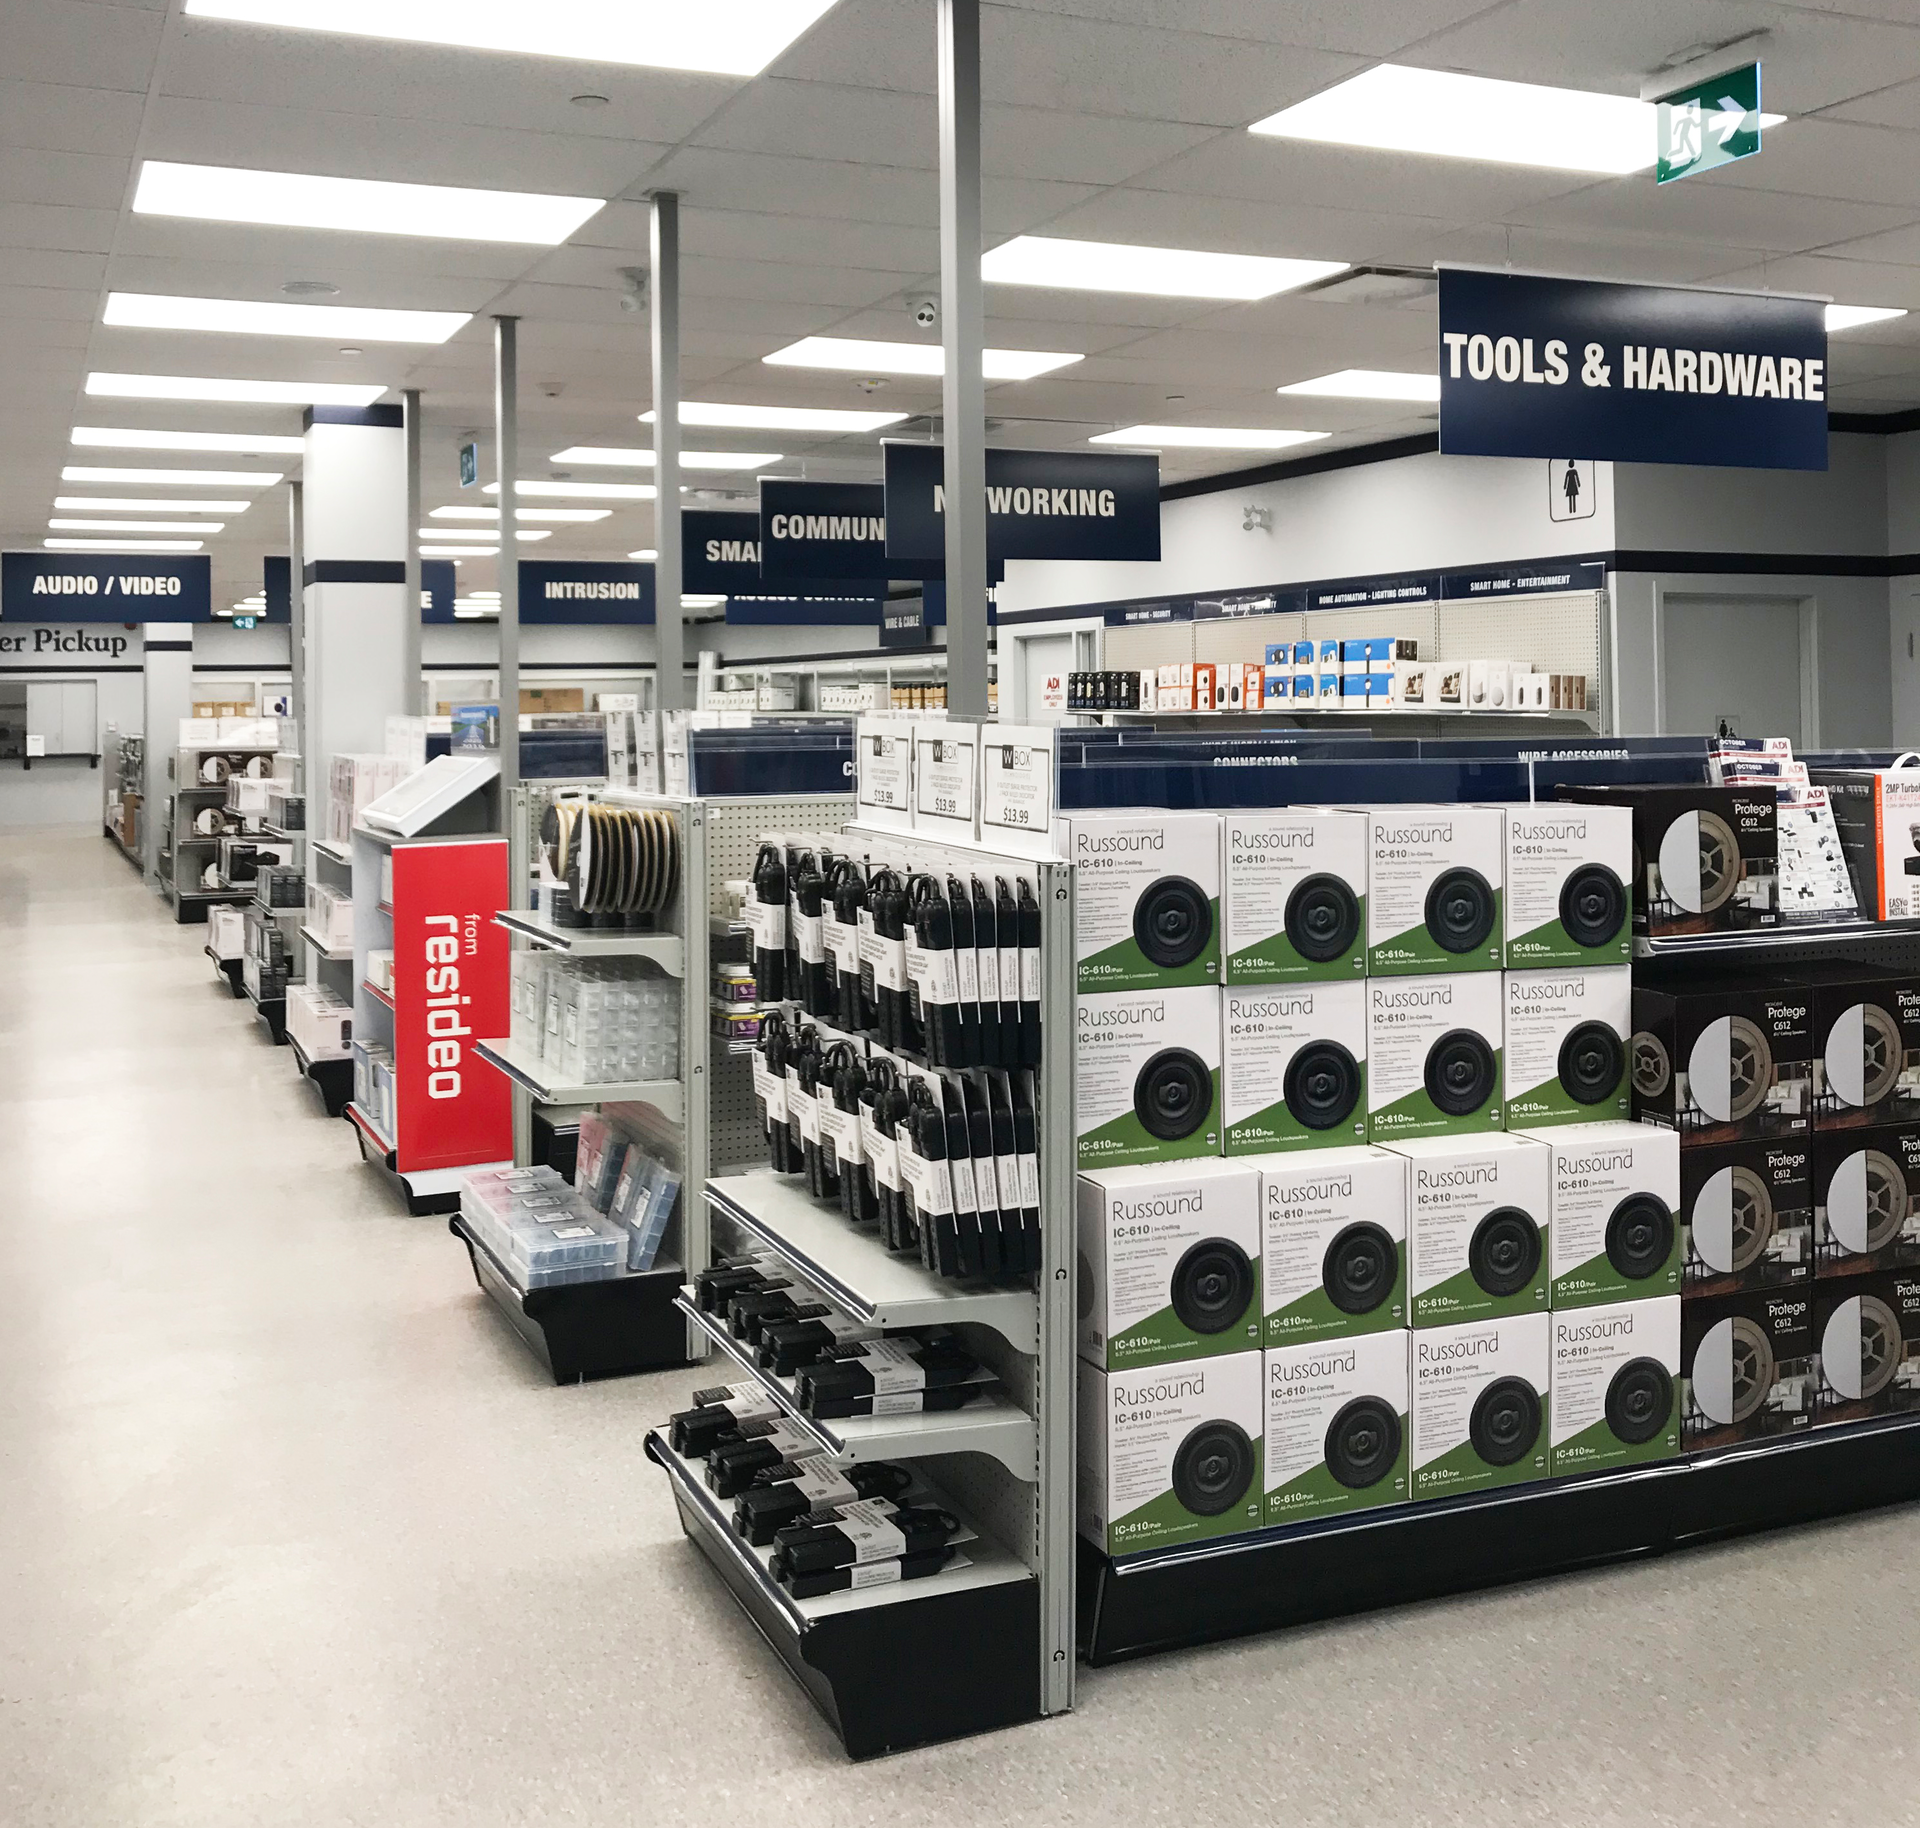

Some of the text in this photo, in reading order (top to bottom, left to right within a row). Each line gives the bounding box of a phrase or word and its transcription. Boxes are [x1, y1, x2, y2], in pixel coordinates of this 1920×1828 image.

[1443, 333, 1824, 401] TOOLS & HARDWARE
[934, 485, 1115, 517] NWORKING
[32, 576, 181, 595] AUDIO / VIDEO
[1470, 582, 1491, 591] SMART
[1493, 580, 1510, 589] HOME
[1517, 575, 1570, 588] ENTERTAINMENT
[545, 582, 640, 599] INTRUSION
[1319, 595, 1334, 604] HOME
[1335, 592, 1366, 603] AUTOMATION
[1372, 590, 1396, 600] LIGHTING
[1398, 587, 1427, 598] CONTROLS
[885, 617, 898, 629] WIRE
[903, 615, 919, 627] CABLE
[0, 629, 127, 657] er Pickup
[1047, 677, 1060, 689] ADI
[1772, 742, 1788, 750] ADI
[1788, 765, 1804, 773] ADI
[1807, 790, 1824, 799] ADI
[1885, 783, 1899, 794] 2MP
[874, 789, 893, 804] $13.99
[935, 796, 956, 813] $13.99
[1735, 803, 1772, 817] Protege
[1003, 806, 1029, 824] $13.99
[1513, 820, 1586, 839] Russound
[1741, 818, 1758, 827] C612
[1232, 827, 1313, 849] Russound
[1375, 822, 1452, 843] Russound
[1078, 829, 1163, 852] Russound
[1376, 850, 1407, 858] IC-610
[1513, 846, 1542, 854] IC-610
[1078, 859, 1113, 868] IC-610
[1232, 855, 1265, 864] IC-610
[1889, 898, 1904, 907] EASY
[1889, 907, 1908, 916] INSTALL
[464, 913, 481, 956] from
[1511, 977, 1584, 1000] Russound
[1373, 984, 1451, 1008] Russound
[424, 914, 471, 1100] resideo
[1078, 1000, 1164, 1027] Russound
[1231, 994, 1313, 1019] Russound
[1511, 1006, 1541, 1014] IC-610
[1768, 1006, 1806, 1020] Protege
[1904, 1008, 1919, 1018] C612
[1374, 1014, 1405, 1023] IC-610
[1231, 1024, 1264, 1034] IC-610
[1773, 1021, 1791, 1031] C612
[1079, 1032, 1114, 1043] IC-610
[1558, 1148, 1632, 1175] Russound
[1768, 1152, 1805, 1168] Protege
[1418, 1161, 1498, 1189] Russound
[1773, 1169, 1791, 1179] C612
[1268, 1174, 1352, 1204] Russound
[1558, 1179, 1588, 1190] IC-610
[1113, 1189, 1202, 1221] Russound
[1418, 1193, 1450, 1204] IC-610
[1269, 1208, 1303, 1220] IC-610
[1114, 1224, 1180, 1238] IC-610 In-Ceiling
[1769, 1301, 1806, 1317] Protege
[1903, 1298, 1919, 1308] C612
[1558, 1314, 1633, 1343] Russound
[1775, 1318, 1792, 1328] C612
[1419, 1331, 1498, 1362] Russound
[1558, 1347, 1588, 1358] IC-610
[1271, 1350, 1355, 1382] Russound
[1419, 1366, 1452, 1378] IC-610
[1114, 1372, 1204, 1408] Russound
[1272, 1386, 1306, 1398] IC-610
[1115, 1408, 1182, 1424] IC-610 In-Ceiling
